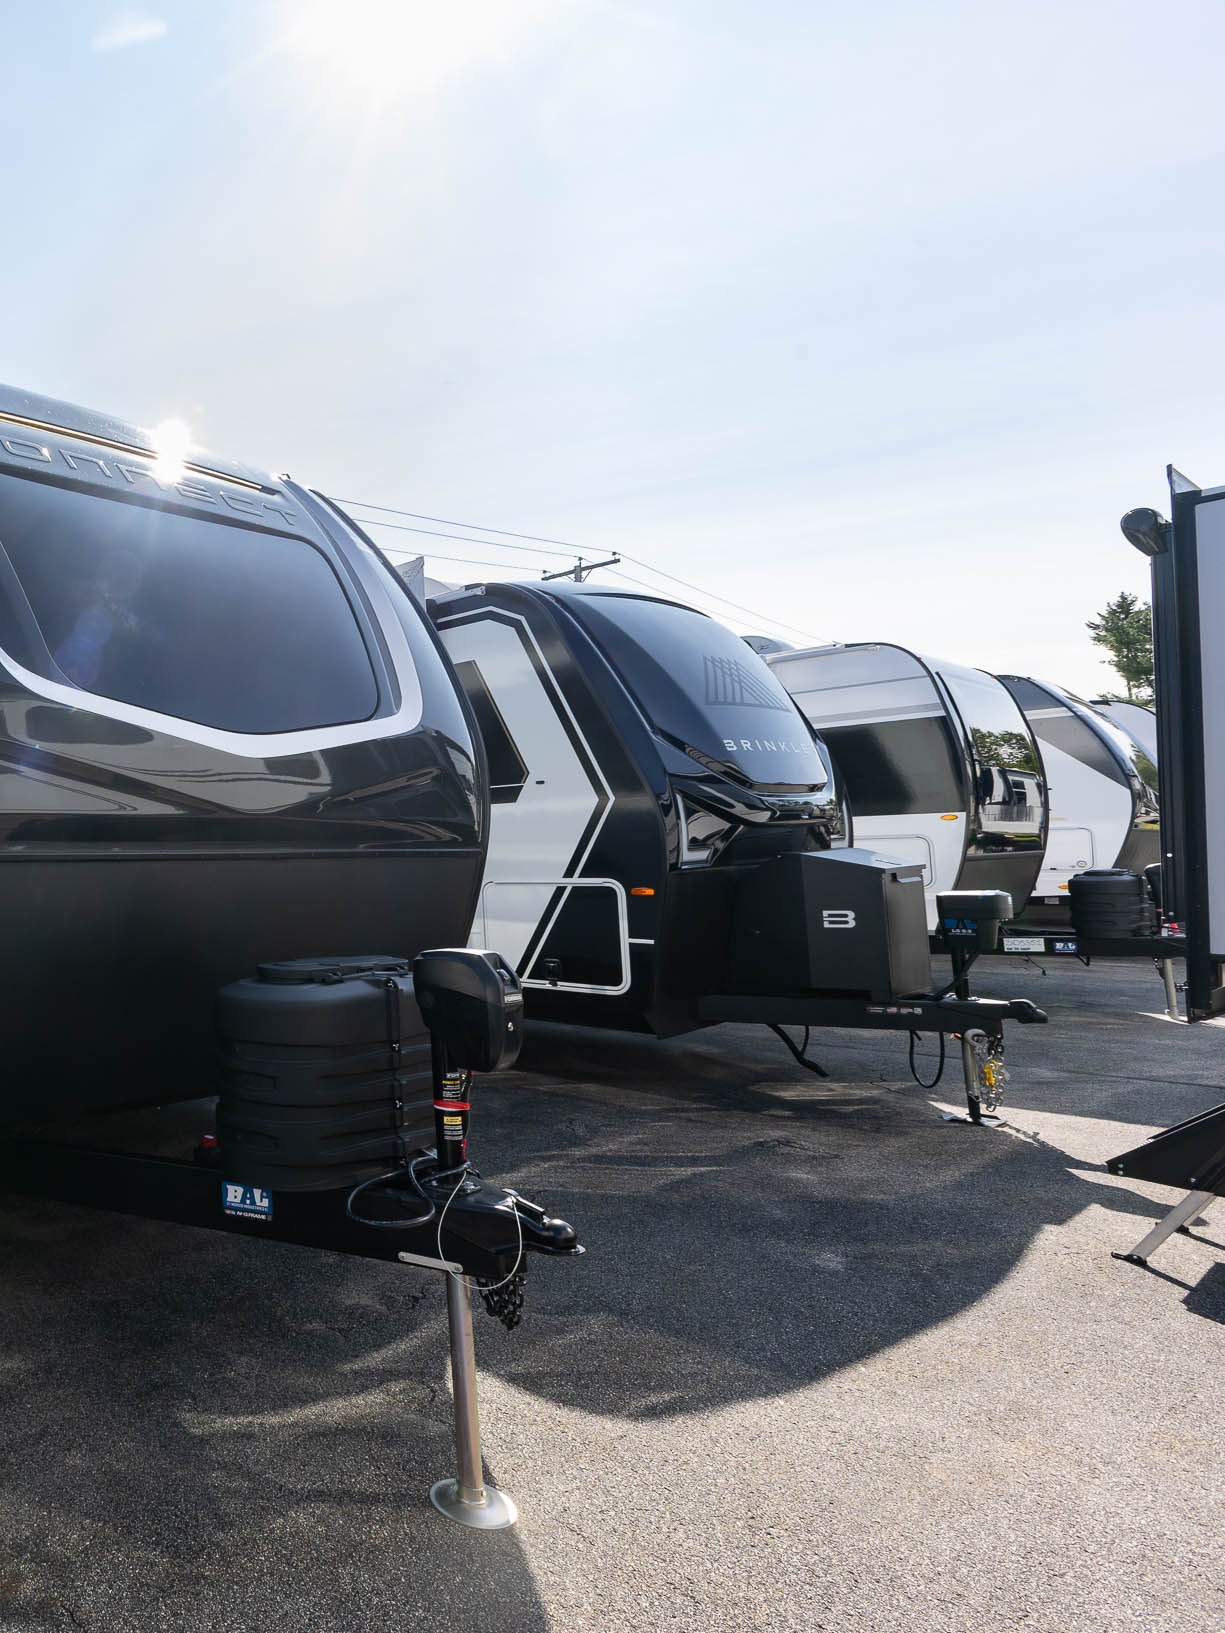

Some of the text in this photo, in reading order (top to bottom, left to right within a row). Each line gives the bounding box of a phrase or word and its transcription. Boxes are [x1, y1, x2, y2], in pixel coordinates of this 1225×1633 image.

[722, 738, 814, 754] BRINKLE
[822, 910, 856, 928] B
[226, 1184, 269, 1207] BAL
